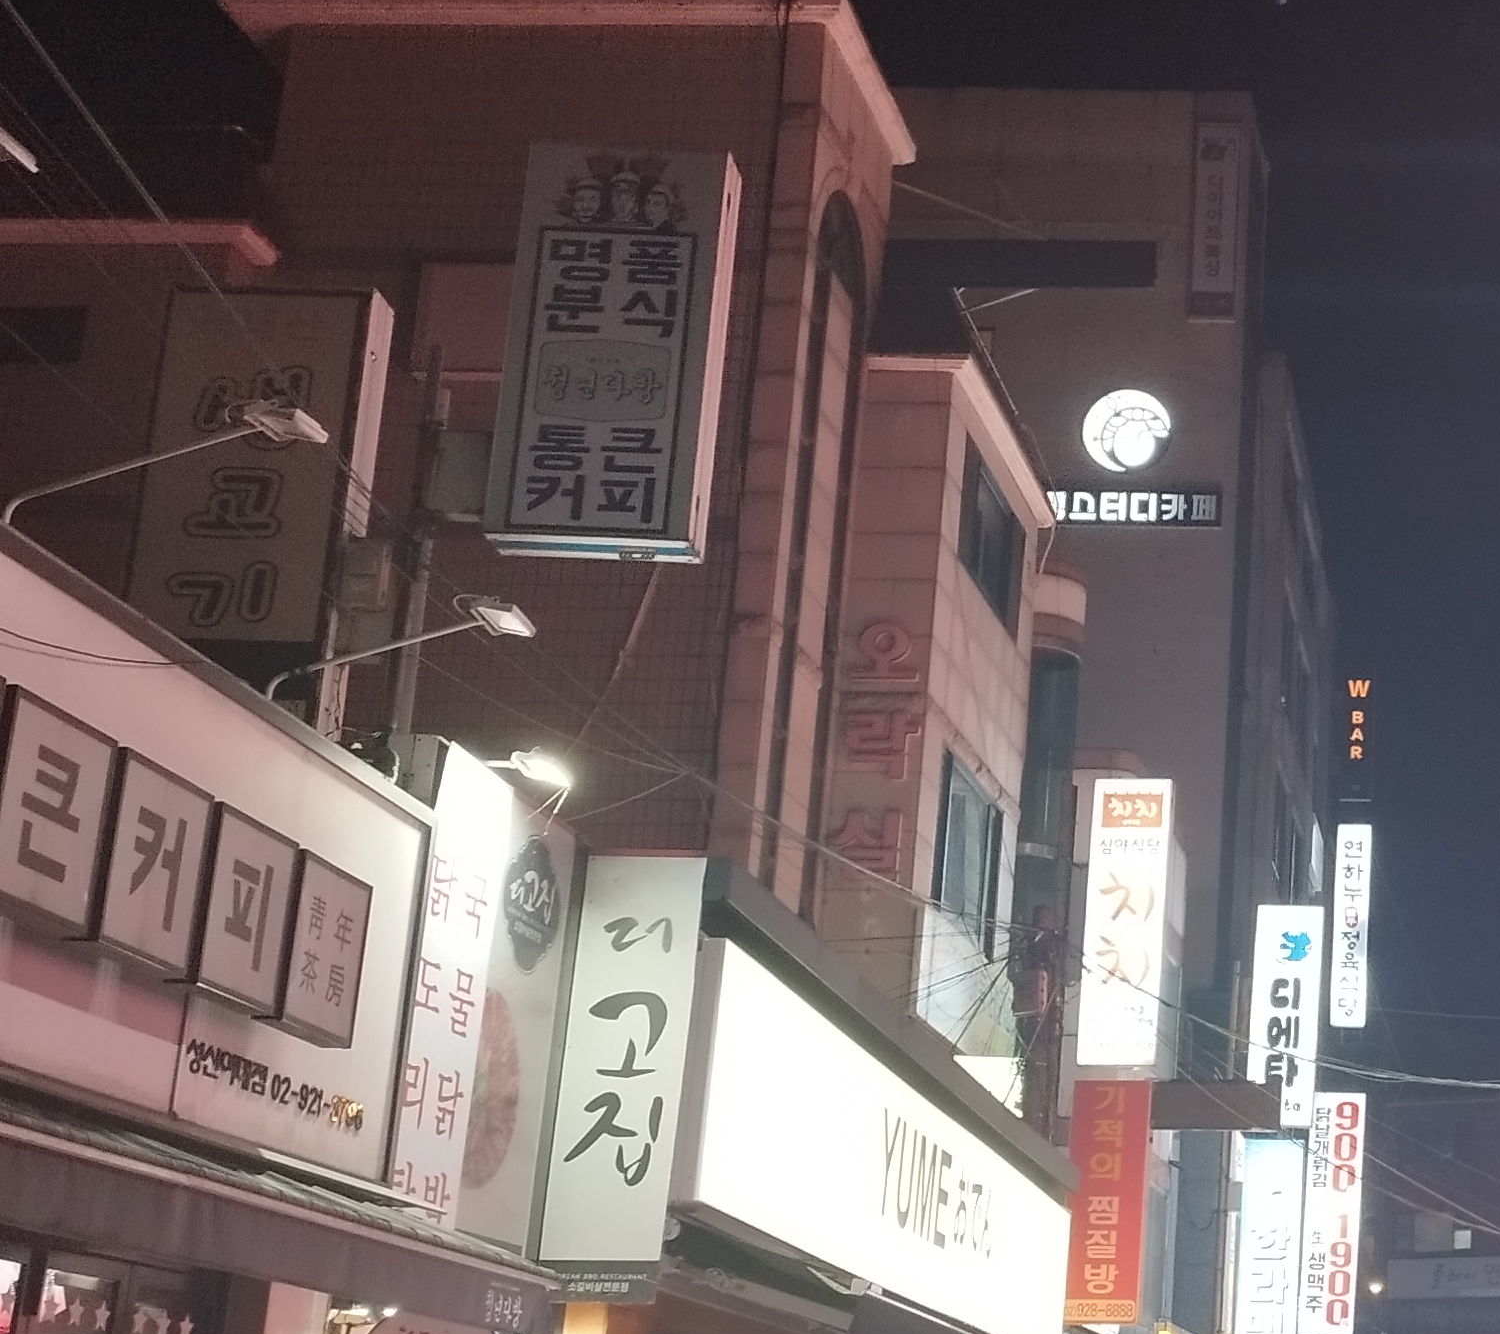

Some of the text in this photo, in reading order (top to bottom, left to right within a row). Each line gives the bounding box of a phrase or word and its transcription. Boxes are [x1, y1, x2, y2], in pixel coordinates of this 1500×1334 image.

[549, 238, 682, 285] 명품
[545, 284, 680, 338] 분식
[528, 423, 663, 473] 통큰
[165, 364, 318, 626] 고기
[526, 474, 656, 523] 커피
[1348, 680, 1371, 760] W BAR
[1100, 838, 1161, 855] 심야식당
[1338, 931, 1360, 1017] 정육식당
[563, 915, 674, 1188] 더고집
[1265, 978, 1301, 1087] 디에타
[880, 1107, 952, 1250] YUME
[1084, 1086, 1126, 1295] 기적의 찜질방
[1333, 1102, 1360, 1193] 900
[1306, 1252, 1327, 1314] 생맥주
[1326, 1214, 1352, 1327] 1900
